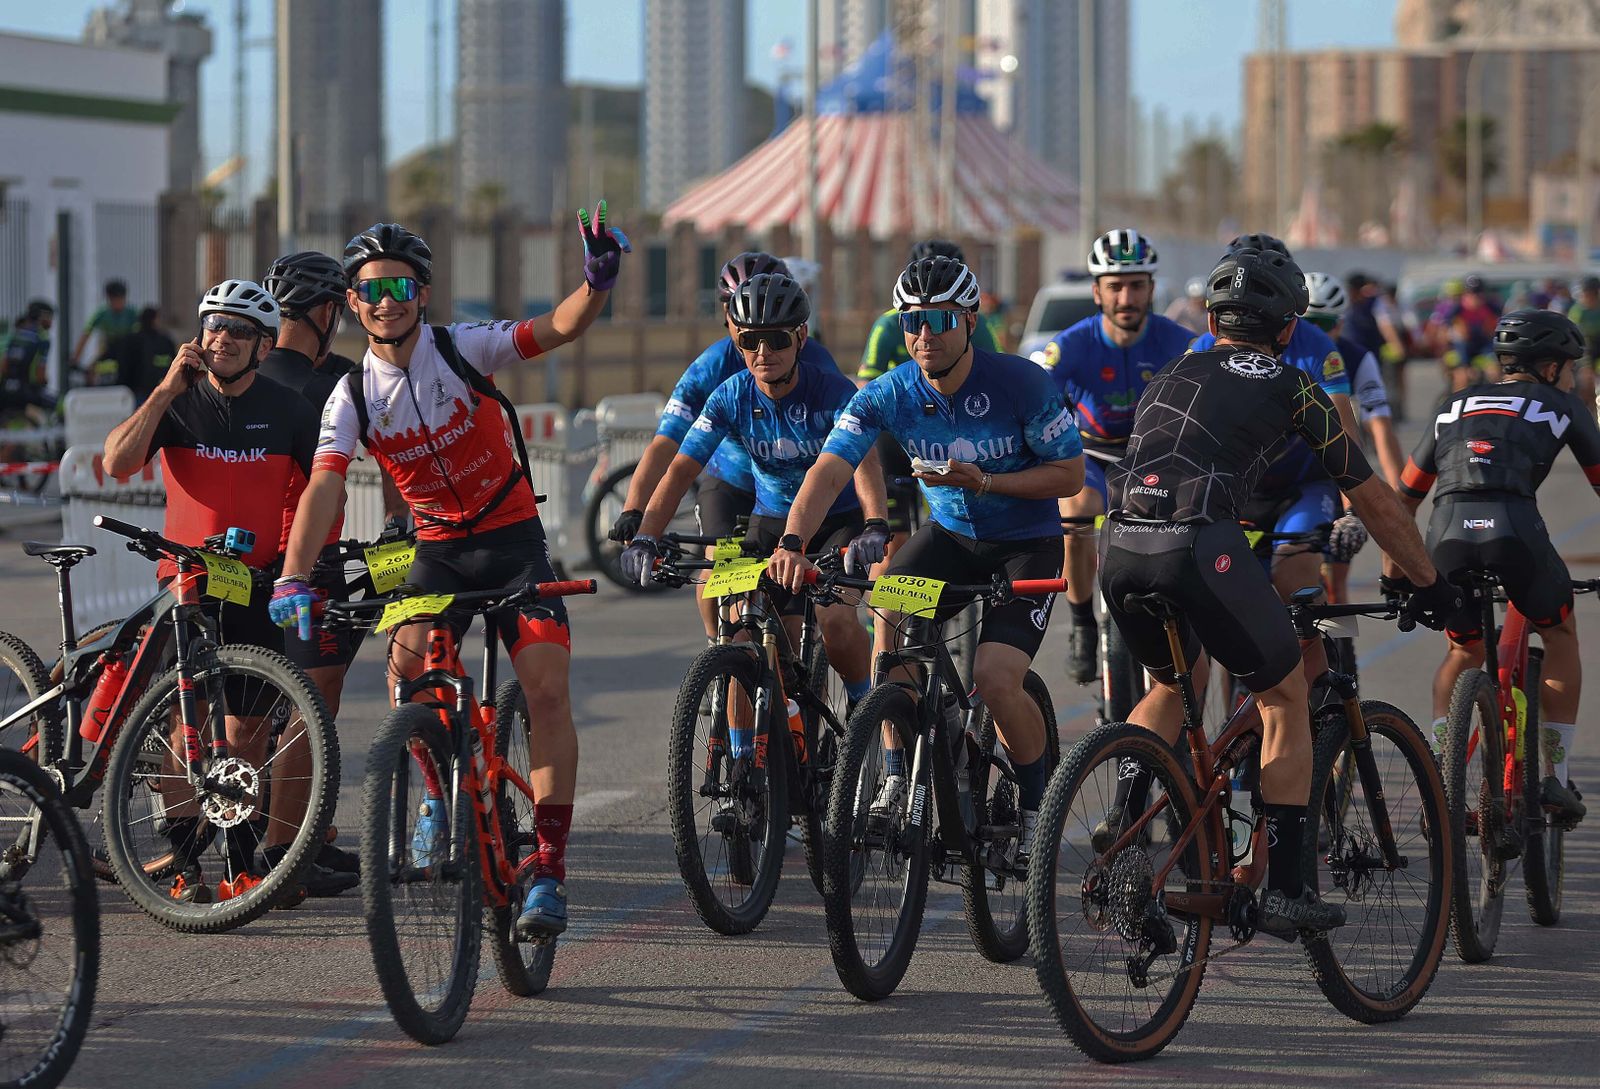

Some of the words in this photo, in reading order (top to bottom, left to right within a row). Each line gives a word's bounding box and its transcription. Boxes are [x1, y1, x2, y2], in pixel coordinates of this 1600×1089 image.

[1463, 519, 1495, 529] NOW
[385, 553, 410, 566] 269
[218, 562, 239, 575] 050
[897, 576, 926, 588] 030
[911, 783, 926, 827] ROCKSHOX
